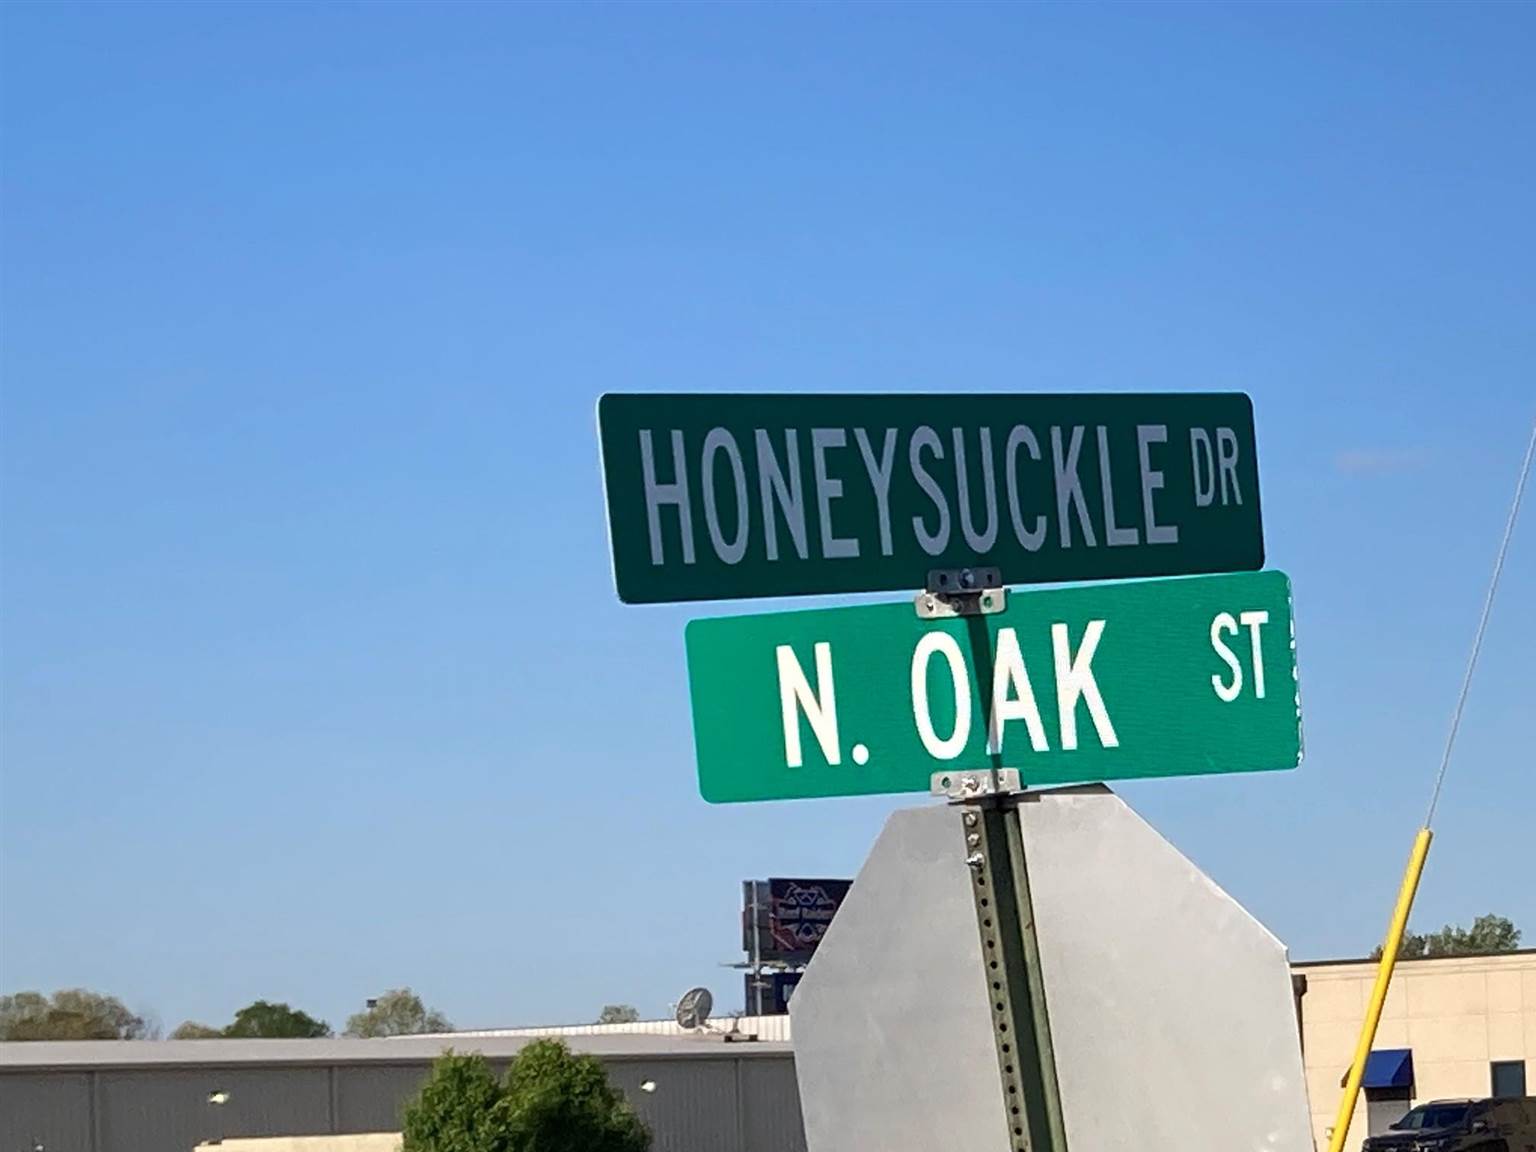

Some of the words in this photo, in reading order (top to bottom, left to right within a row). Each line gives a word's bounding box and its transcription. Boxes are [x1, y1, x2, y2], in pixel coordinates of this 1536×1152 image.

[638, 424, 1179, 565] HONEYSUCKLE
[1190, 426, 1243, 507] DR
[775, 641, 869, 767] N.
[911, 619, 1120, 759] OAK
[1210, 610, 1269, 702] ST
